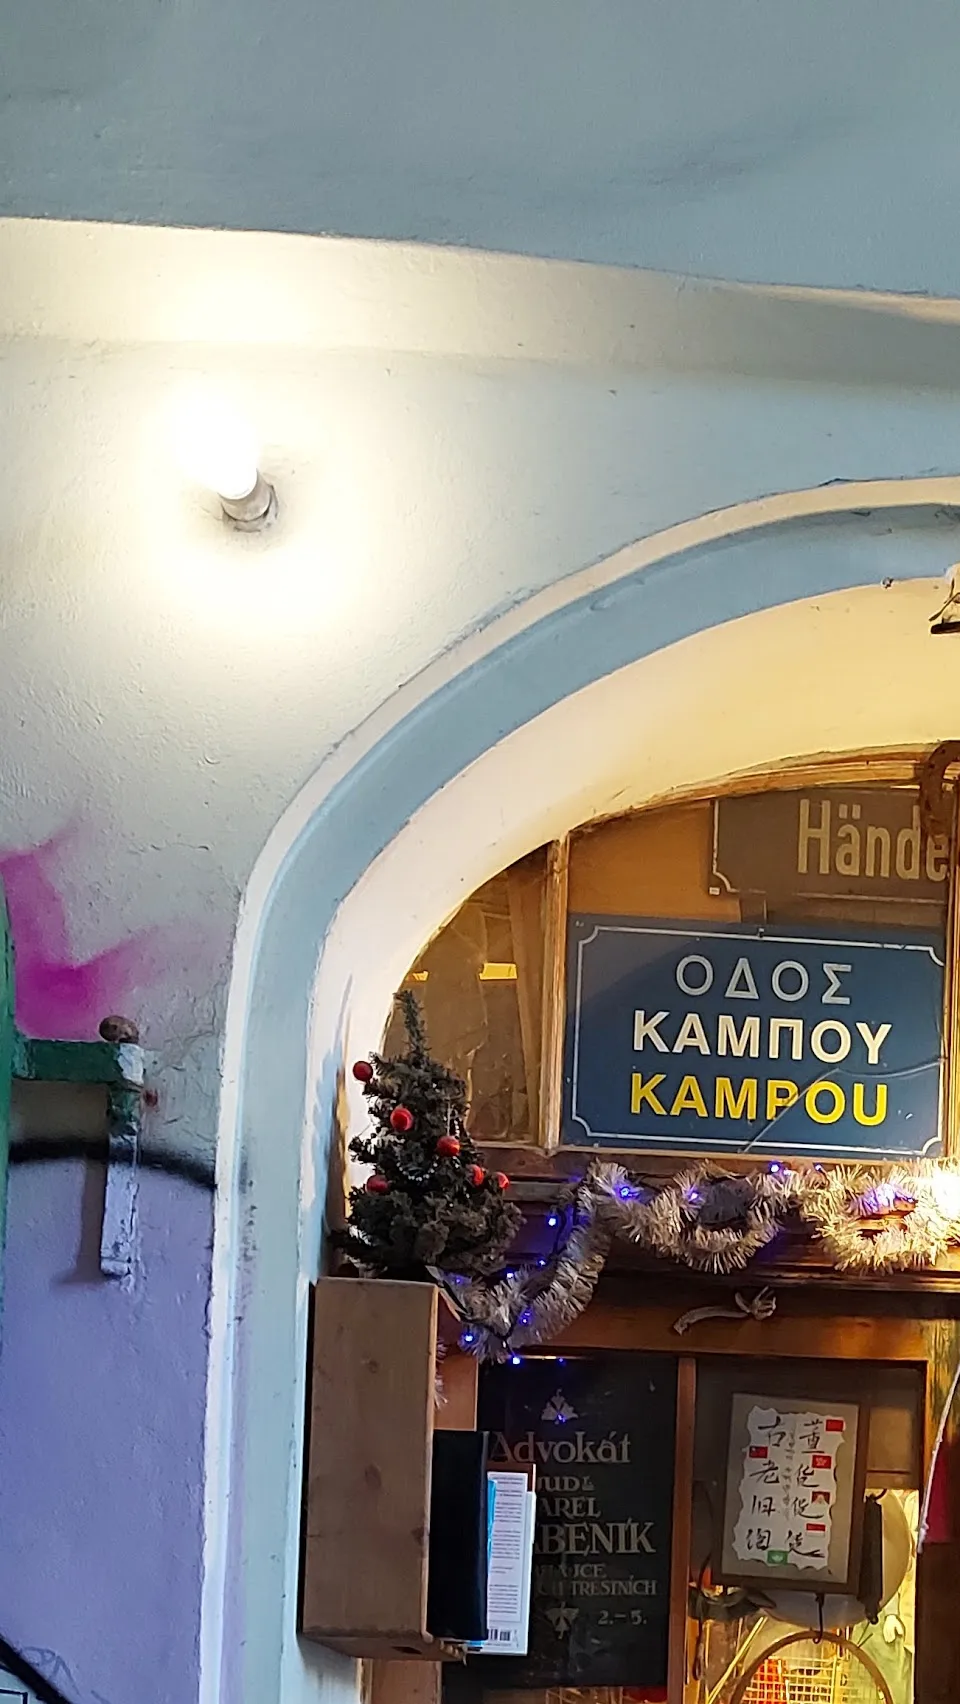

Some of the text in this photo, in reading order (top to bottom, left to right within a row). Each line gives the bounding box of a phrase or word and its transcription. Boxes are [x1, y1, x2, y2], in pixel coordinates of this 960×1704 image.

[675, 954, 852, 1005] ΟΔΟΣ
[633, 1009, 892, 1065] ΚΑΜΠΟΥ
[630, 1072, 888, 1127] KAMPOU
[489, 1430, 631, 1464] Advokát
[539, 1496, 601, 1519] AREL
